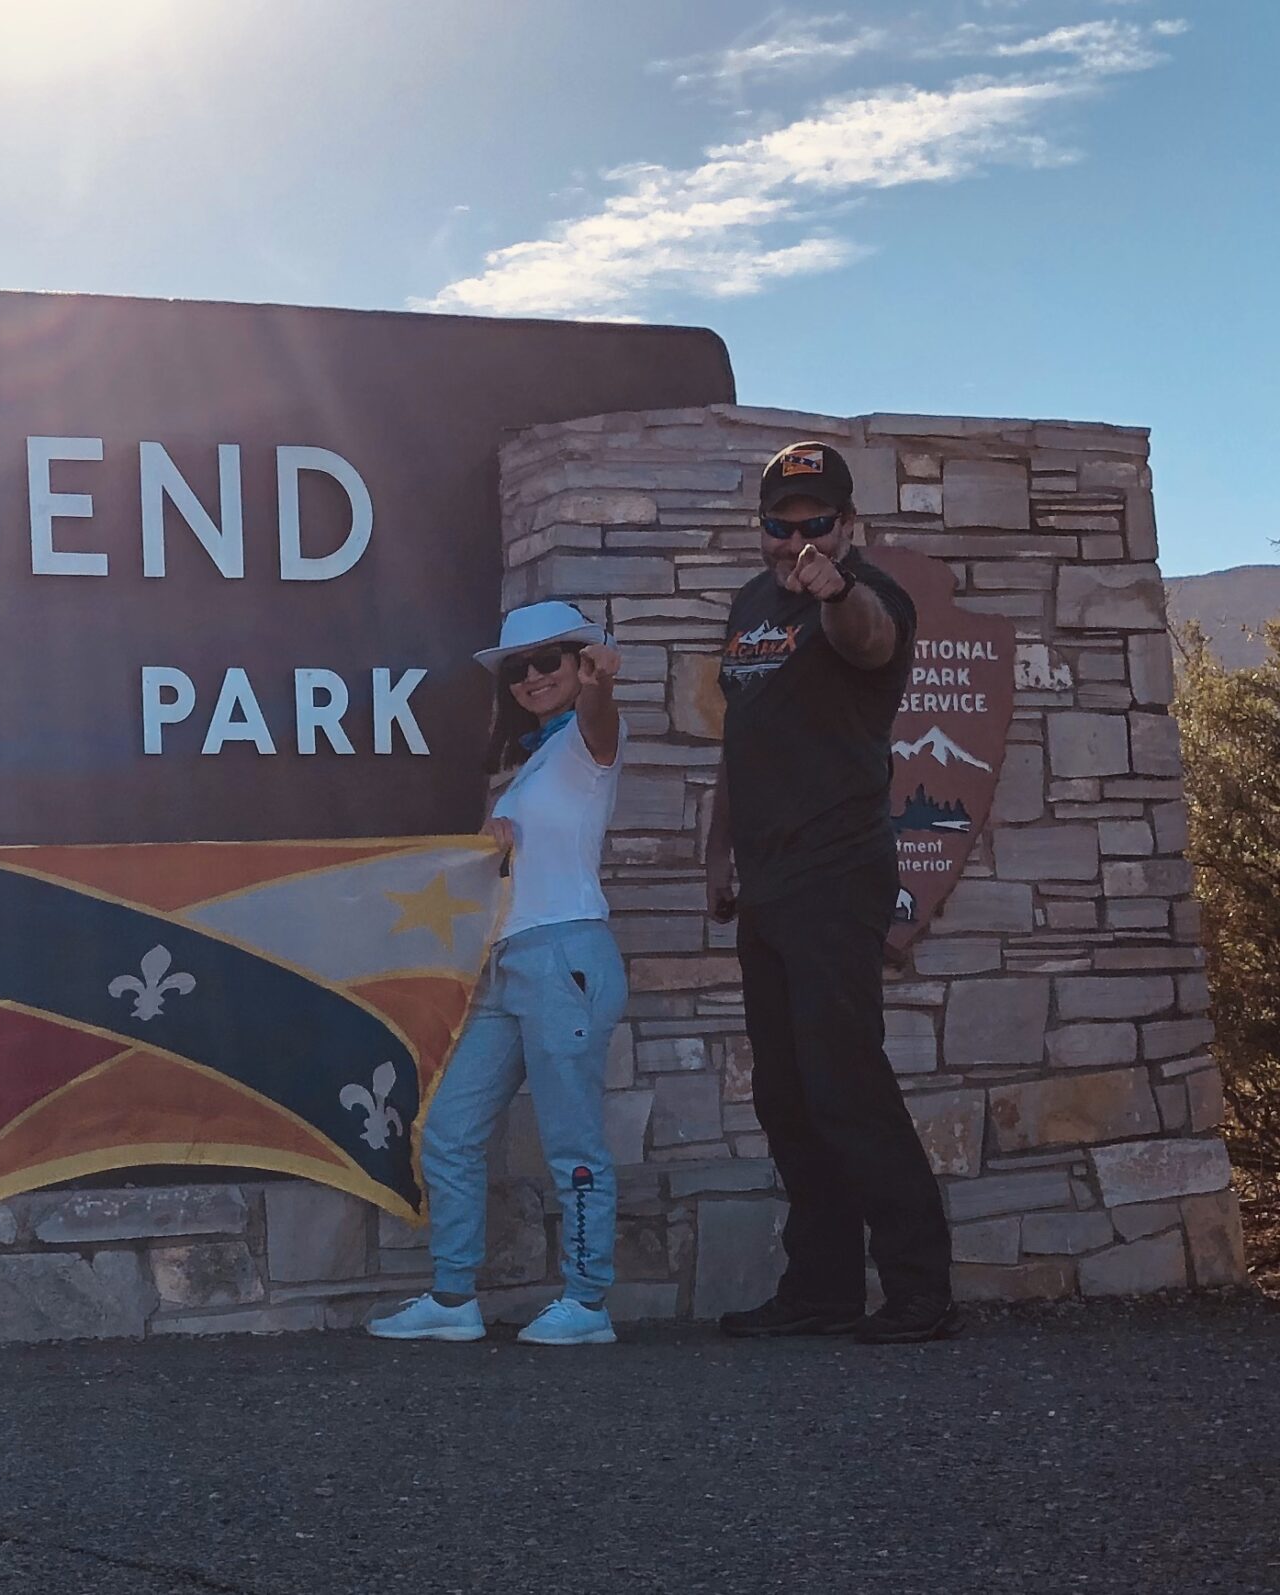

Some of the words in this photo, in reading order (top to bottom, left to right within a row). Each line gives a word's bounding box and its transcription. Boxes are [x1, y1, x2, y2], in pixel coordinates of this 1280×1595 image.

[914, 640, 999, 661] TIONAL
[912, 667, 971, 686] PARK
[141, 666, 431, 755] PARK
[897, 692, 988, 713] SERVICE
[896, 838, 943, 854] tment
[898, 857, 953, 873] nterior
